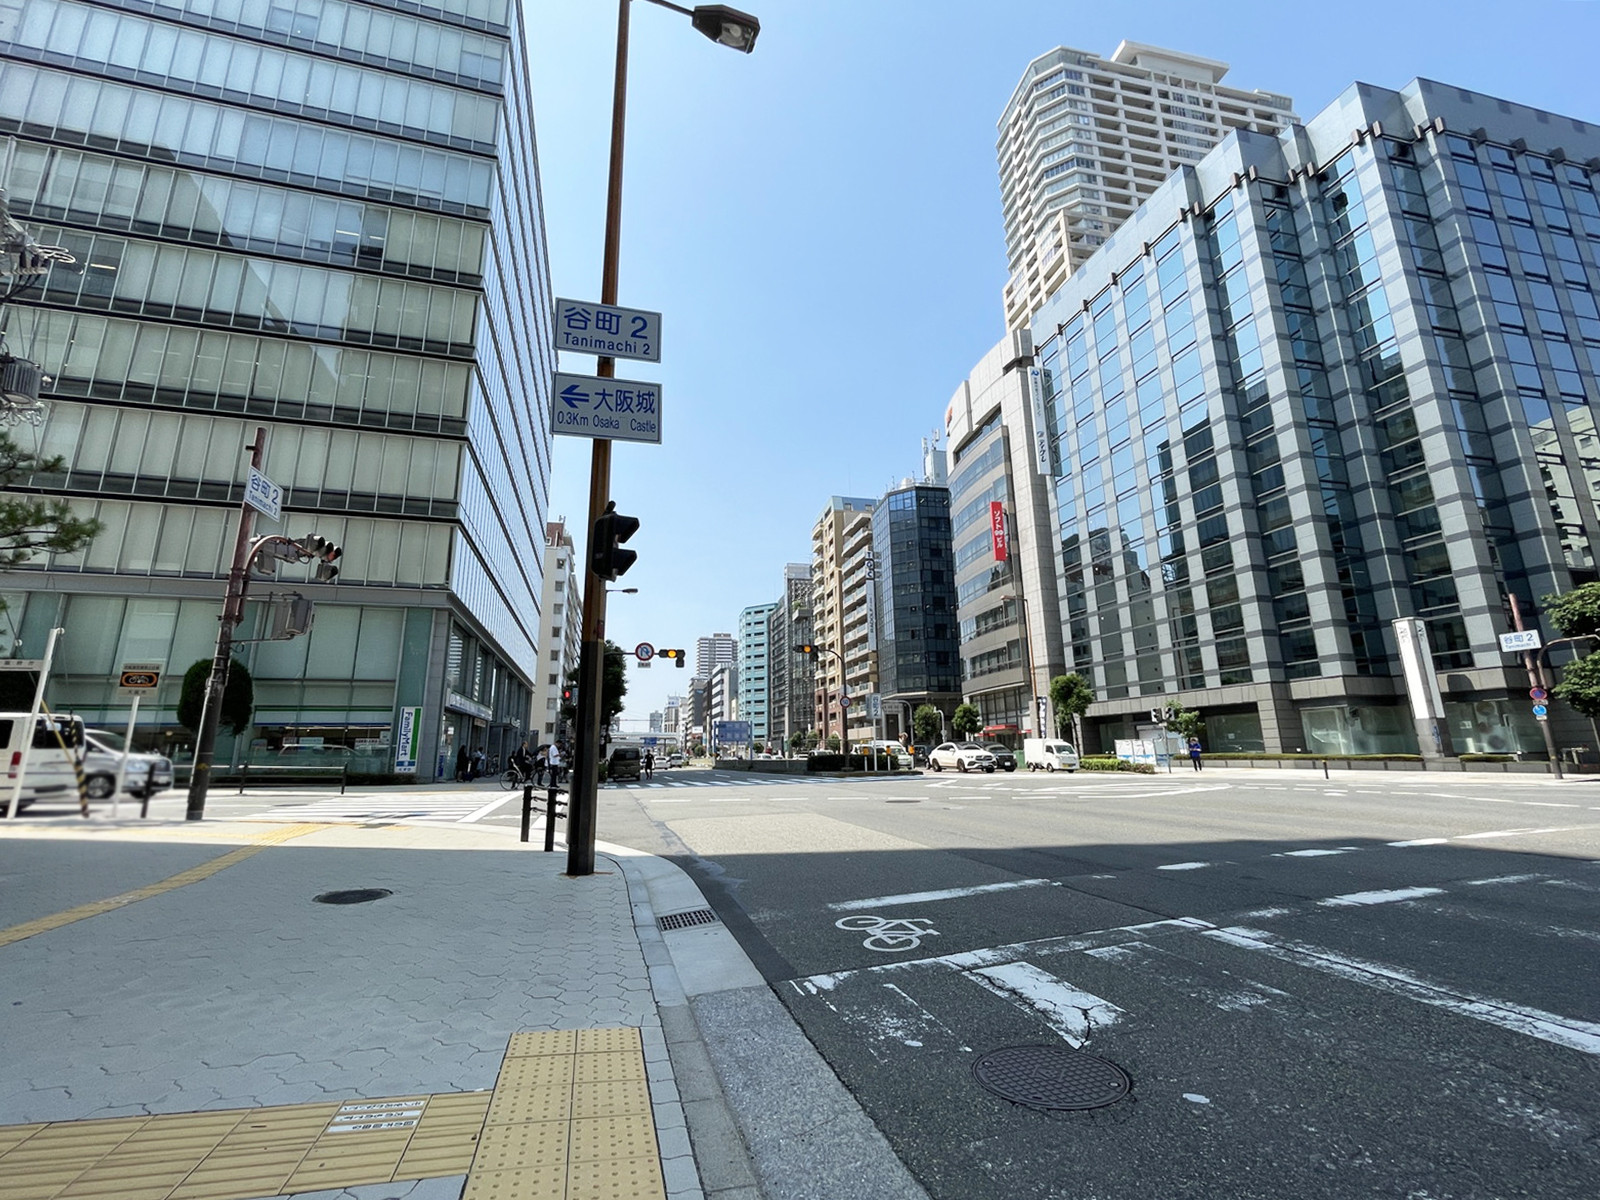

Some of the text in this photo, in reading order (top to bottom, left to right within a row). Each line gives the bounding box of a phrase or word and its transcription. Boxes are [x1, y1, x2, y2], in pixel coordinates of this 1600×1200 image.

[564, 307, 648, 340] 谷町2
[563, 332, 650, 355] Tanimachi 2
[593, 388, 656, 415] 大阪城
[557, 411, 657, 433] 0.3Km Osaka Castle
[400, 711, 414, 757] FamilyMart
